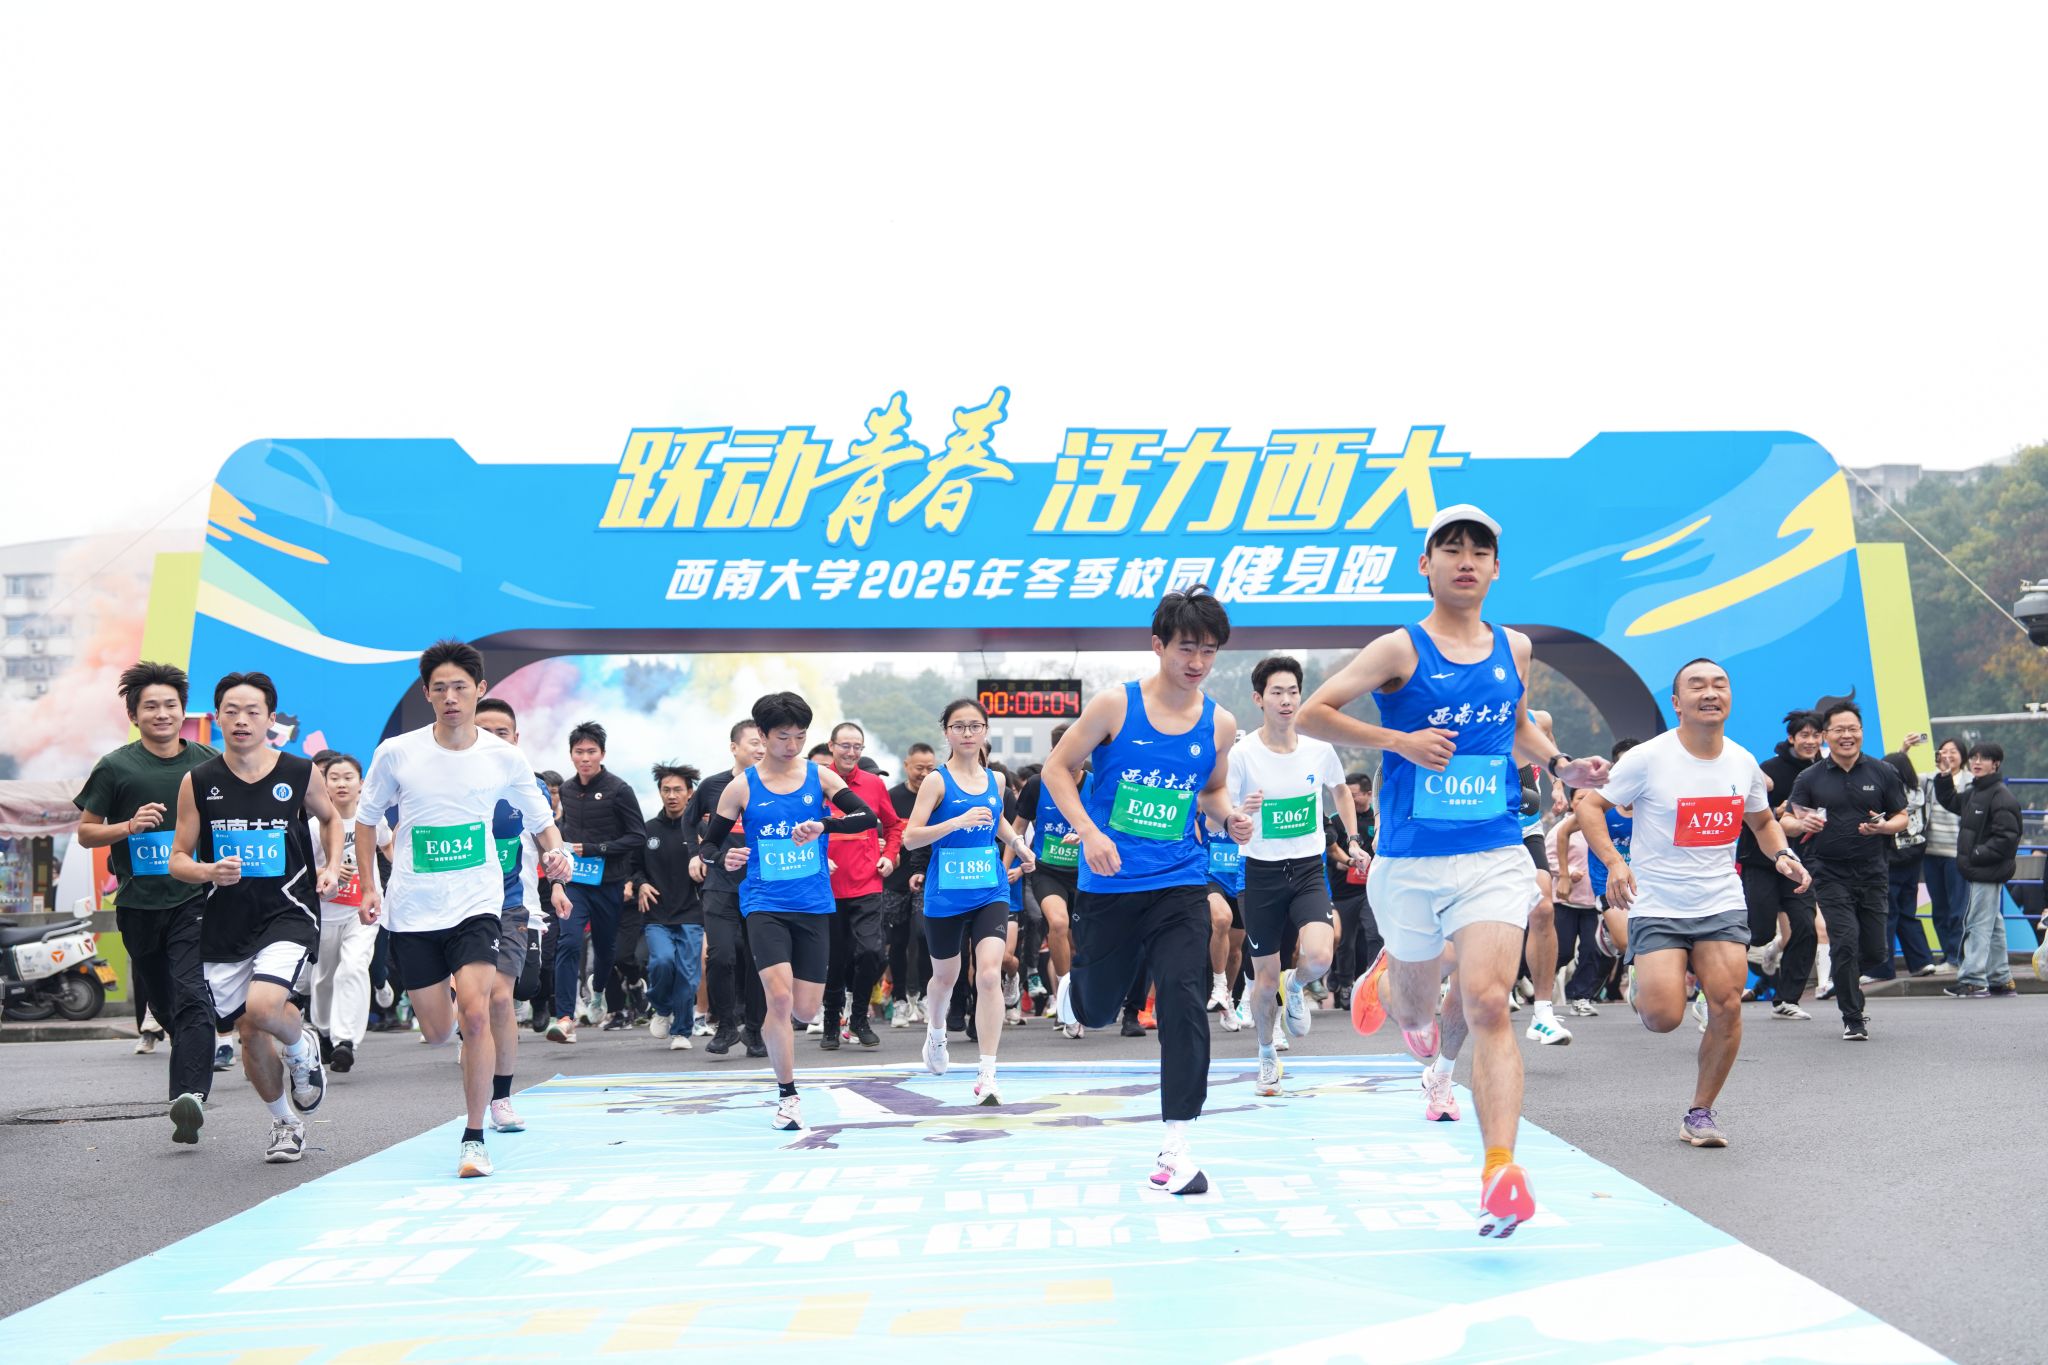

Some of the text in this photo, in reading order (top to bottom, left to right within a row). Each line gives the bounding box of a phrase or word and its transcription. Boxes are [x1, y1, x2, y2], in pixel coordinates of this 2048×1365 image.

[598, 388, 1465, 548] 跃动青春 活力西大
[665, 545, 1398, 602] 西南大学2025年冬季校园健身跑
[980, 691, 1079, 715] 00:00:04
[1424, 774, 1497, 795] C0604
[1127, 798, 1177, 821] E030
[1272, 807, 1310, 824] E067
[1688, 811, 1733, 828] A793
[136, 843, 173, 860] C10
[219, 843, 278, 861] C1516
[425, 837, 473, 855] E034
[1049, 845, 1078, 858] E055
[764, 847, 815, 866] C1846
[572, 861, 600, 874] 2132
[944, 860, 992, 874] C1886
